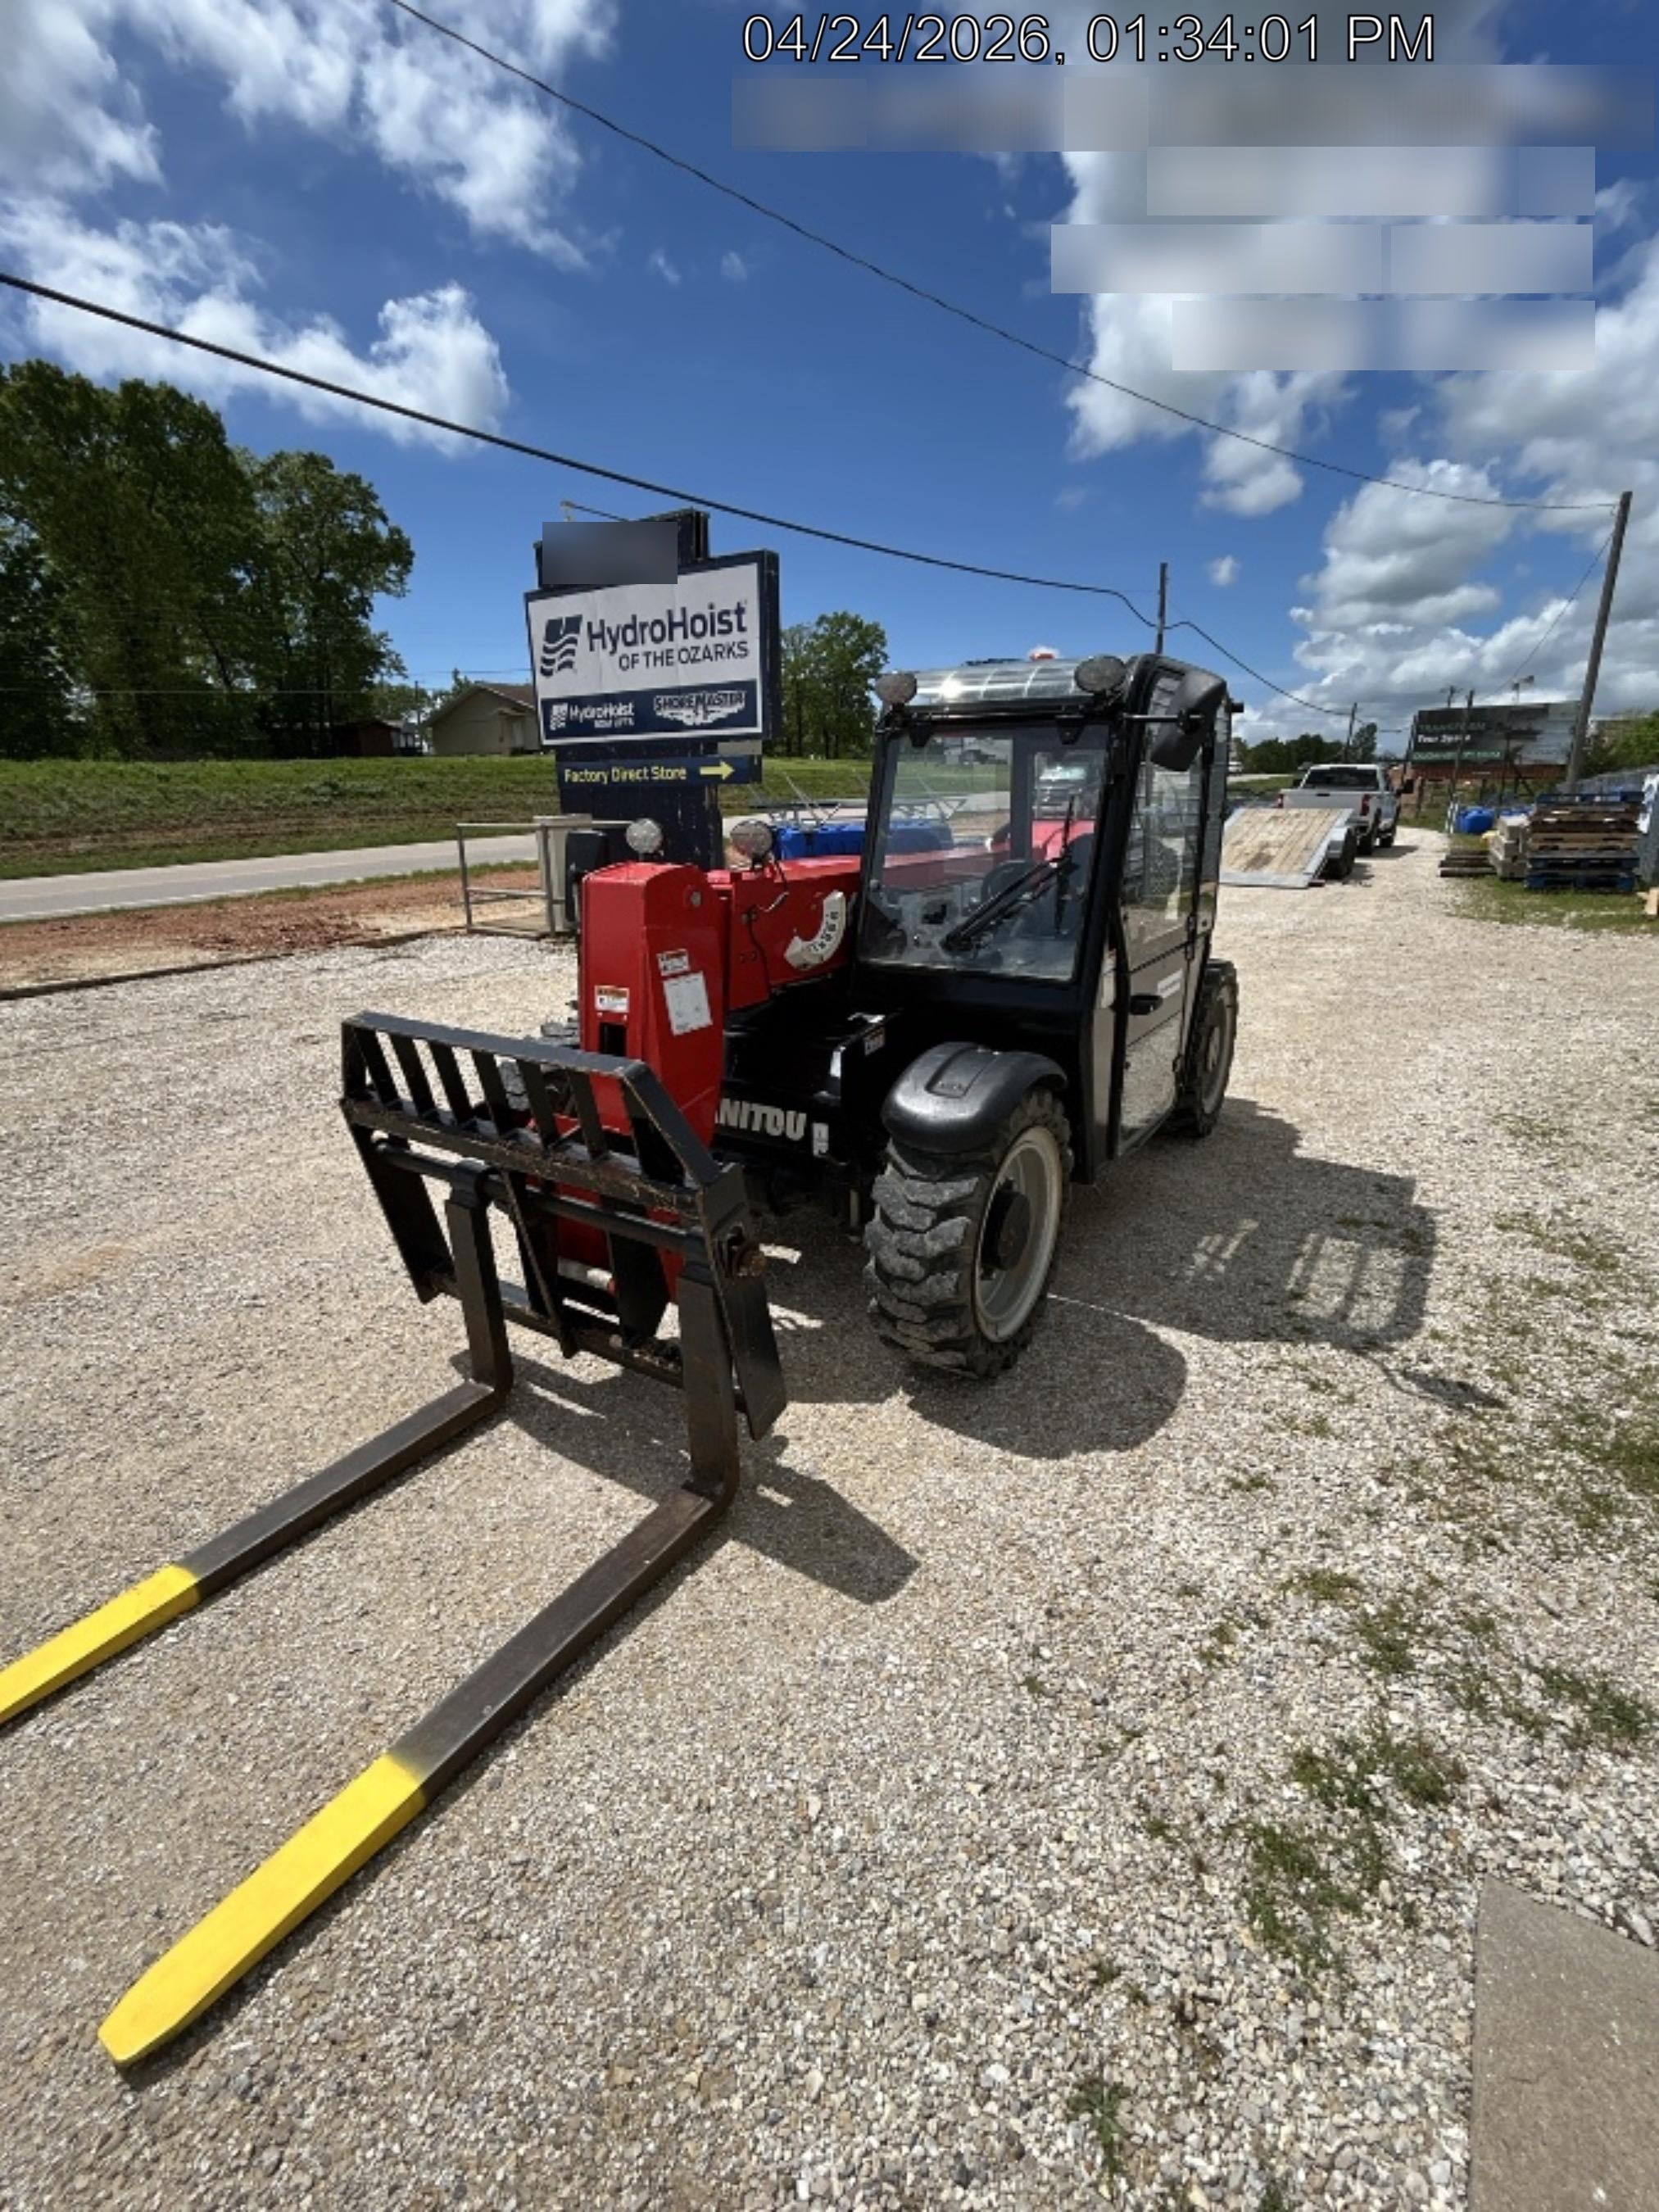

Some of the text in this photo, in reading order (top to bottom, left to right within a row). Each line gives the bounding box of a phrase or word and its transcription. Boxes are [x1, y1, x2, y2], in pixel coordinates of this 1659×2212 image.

[587, 602, 747, 655] HydroHoist
[619, 641, 749, 671] OF THE OZARKS
[564, 765, 687, 785] Factory Direct Store
[715, 1098, 807, 1141] NITOU
